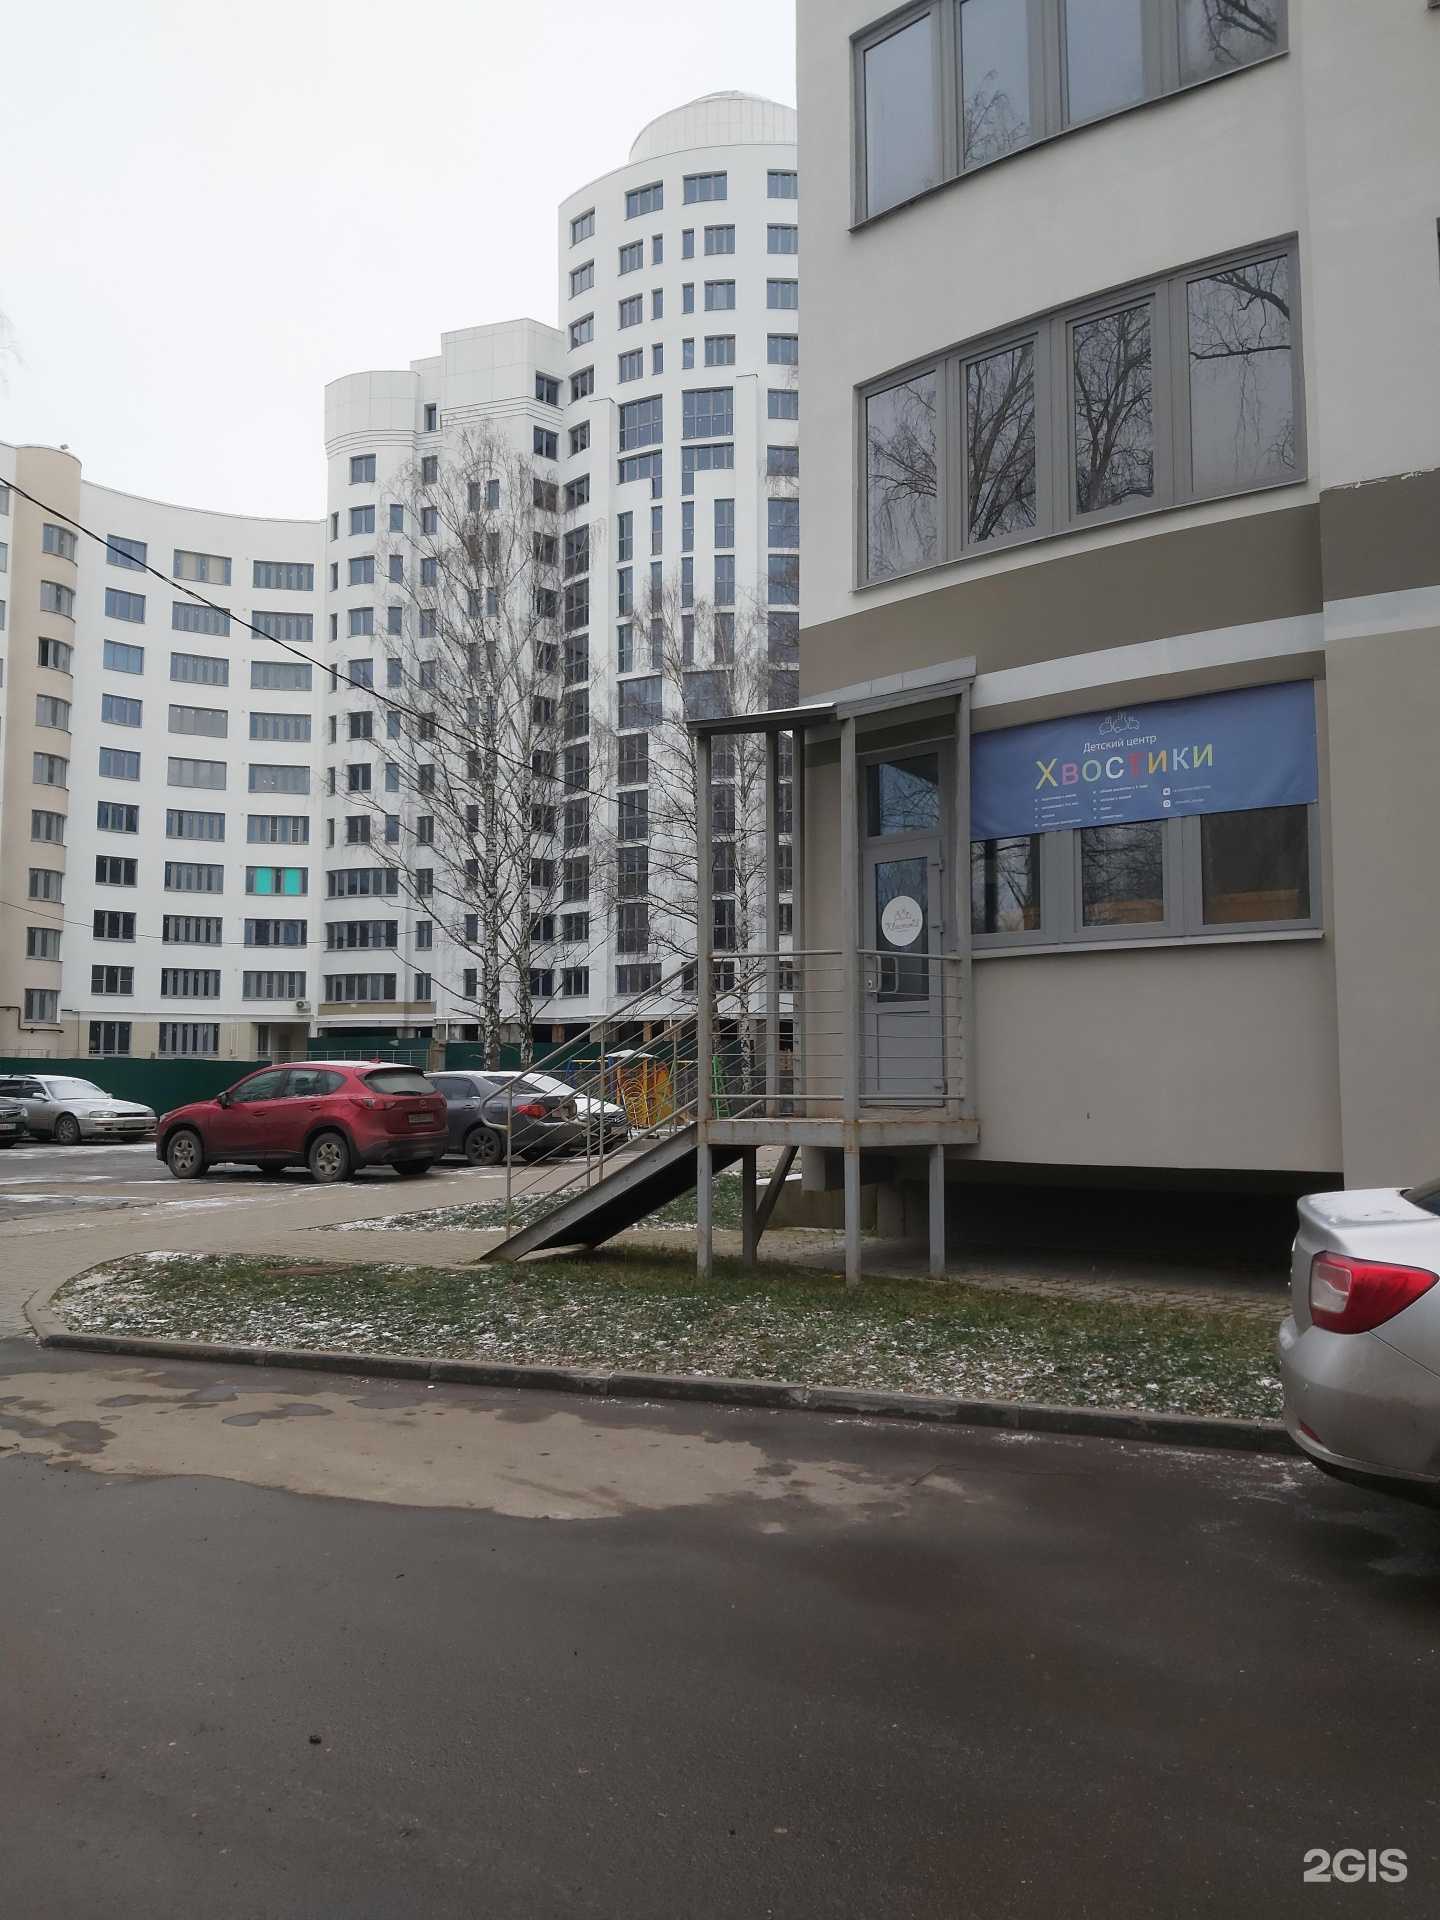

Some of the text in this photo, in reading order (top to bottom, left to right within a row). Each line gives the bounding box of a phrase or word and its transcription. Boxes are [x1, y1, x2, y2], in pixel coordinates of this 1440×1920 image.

[1082, 735, 1157, 754] Детский центр
[1035, 743, 1214, 789] ХВОСТИКИ
